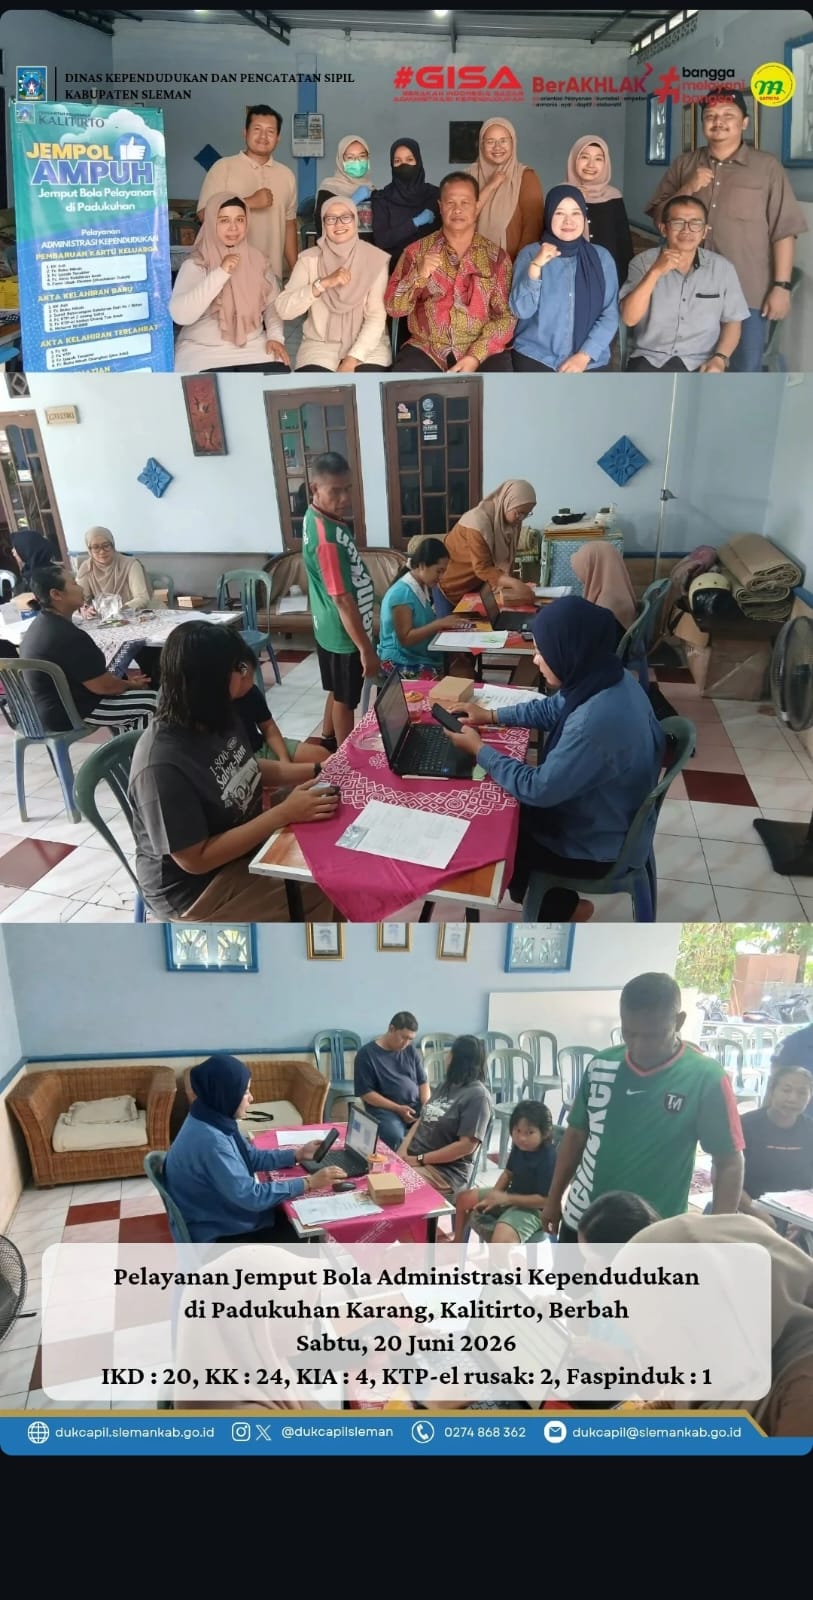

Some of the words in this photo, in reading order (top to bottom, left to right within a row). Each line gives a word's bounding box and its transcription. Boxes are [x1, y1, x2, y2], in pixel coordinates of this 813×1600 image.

[38, 116, 105, 128] KALITIRTO
[26, 142, 113, 160] JEMPOL
[31, 160, 154, 185] AMPUH
[38, 188, 78, 200] Jemput
[80, 188, 102, 197] Bola
[104, 188, 154, 199] Pelayanan
[65, 203, 76, 212] di
[78, 202, 136, 212] Padukuhan
[41, 239, 98, 248] ADMINISTRASI
[99, 235, 159, 245] KEPENDUDUKAN
[89, 248, 117, 256] KARTU
[63, 288, 110, 299] KELAHIRAN
[111, 286, 133, 294] BARU
[65, 332, 112, 343] KELAHIRAN
[335, 526, 374, 643] eineken
